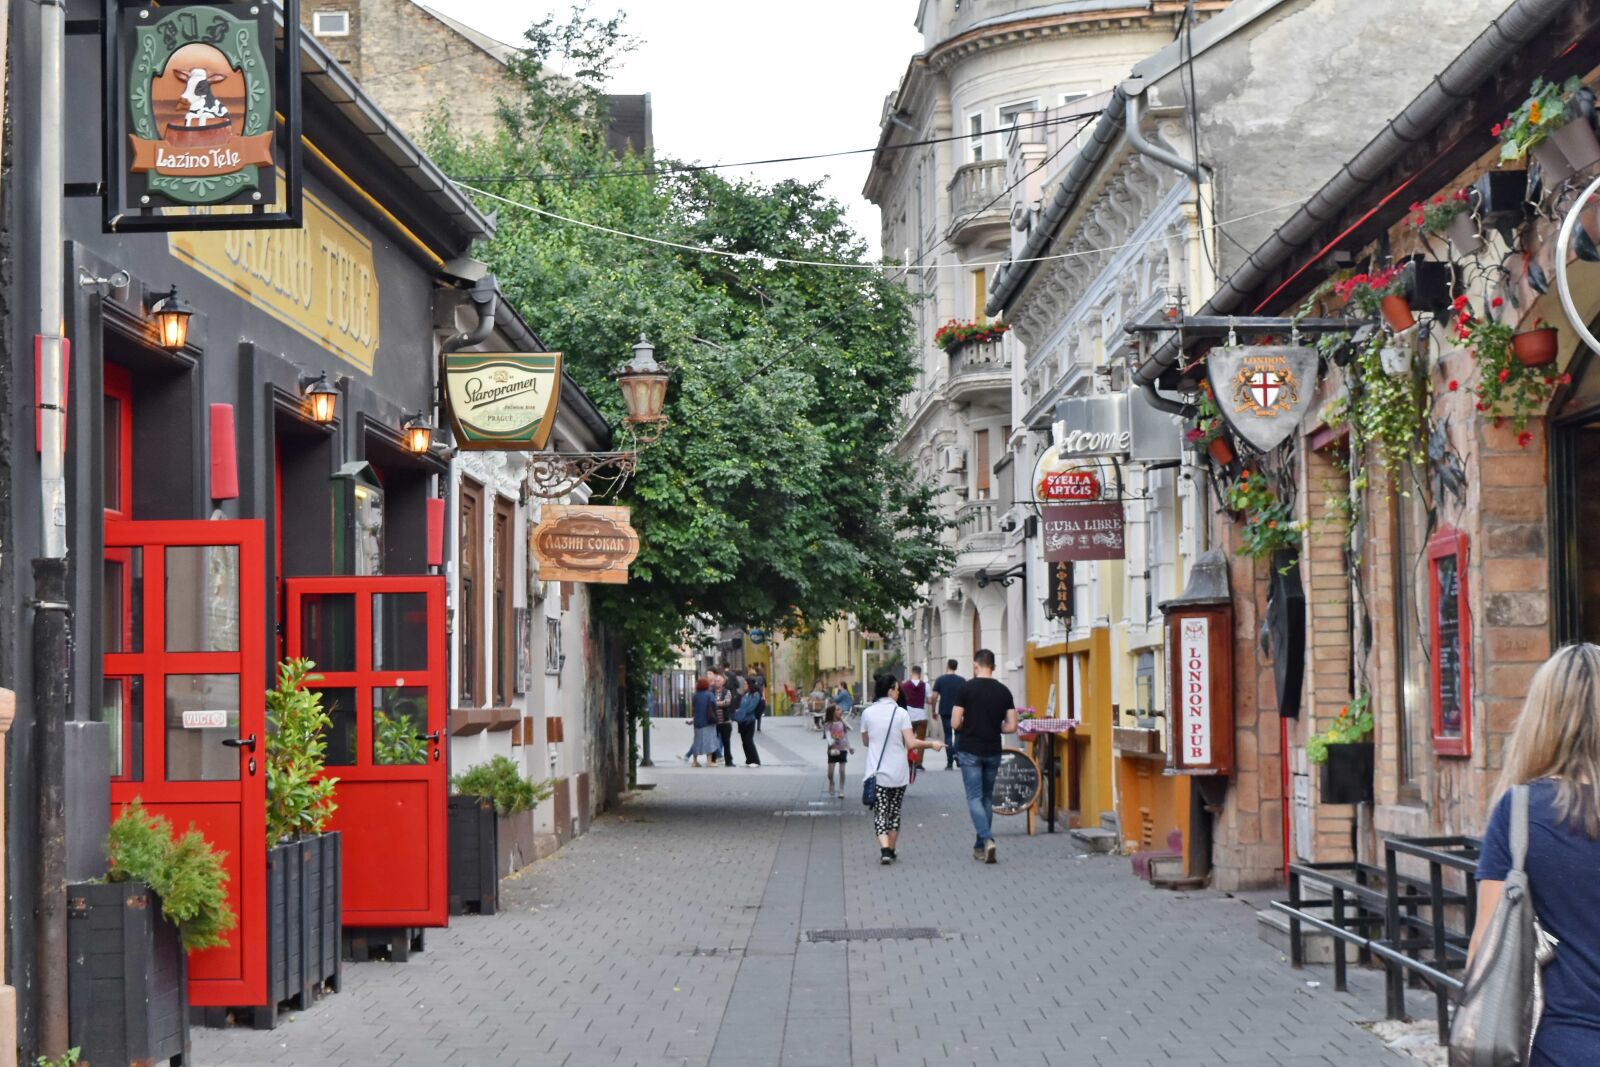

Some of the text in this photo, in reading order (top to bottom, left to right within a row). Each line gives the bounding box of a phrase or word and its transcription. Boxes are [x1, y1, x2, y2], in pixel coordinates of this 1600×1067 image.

[156, 148, 240, 168] Lazino Tele
[320, 230, 372, 347] TELE
[464, 377, 538, 410] Staropramen
[1047, 475, 1091, 485] STELLA
[1049, 485, 1092, 495] ARTOIS
[1045, 519, 1122, 531] CUBA LIBRE
[588, 537, 624, 551] СОКАК
[1188, 647, 1203, 758] LONDON PUB
